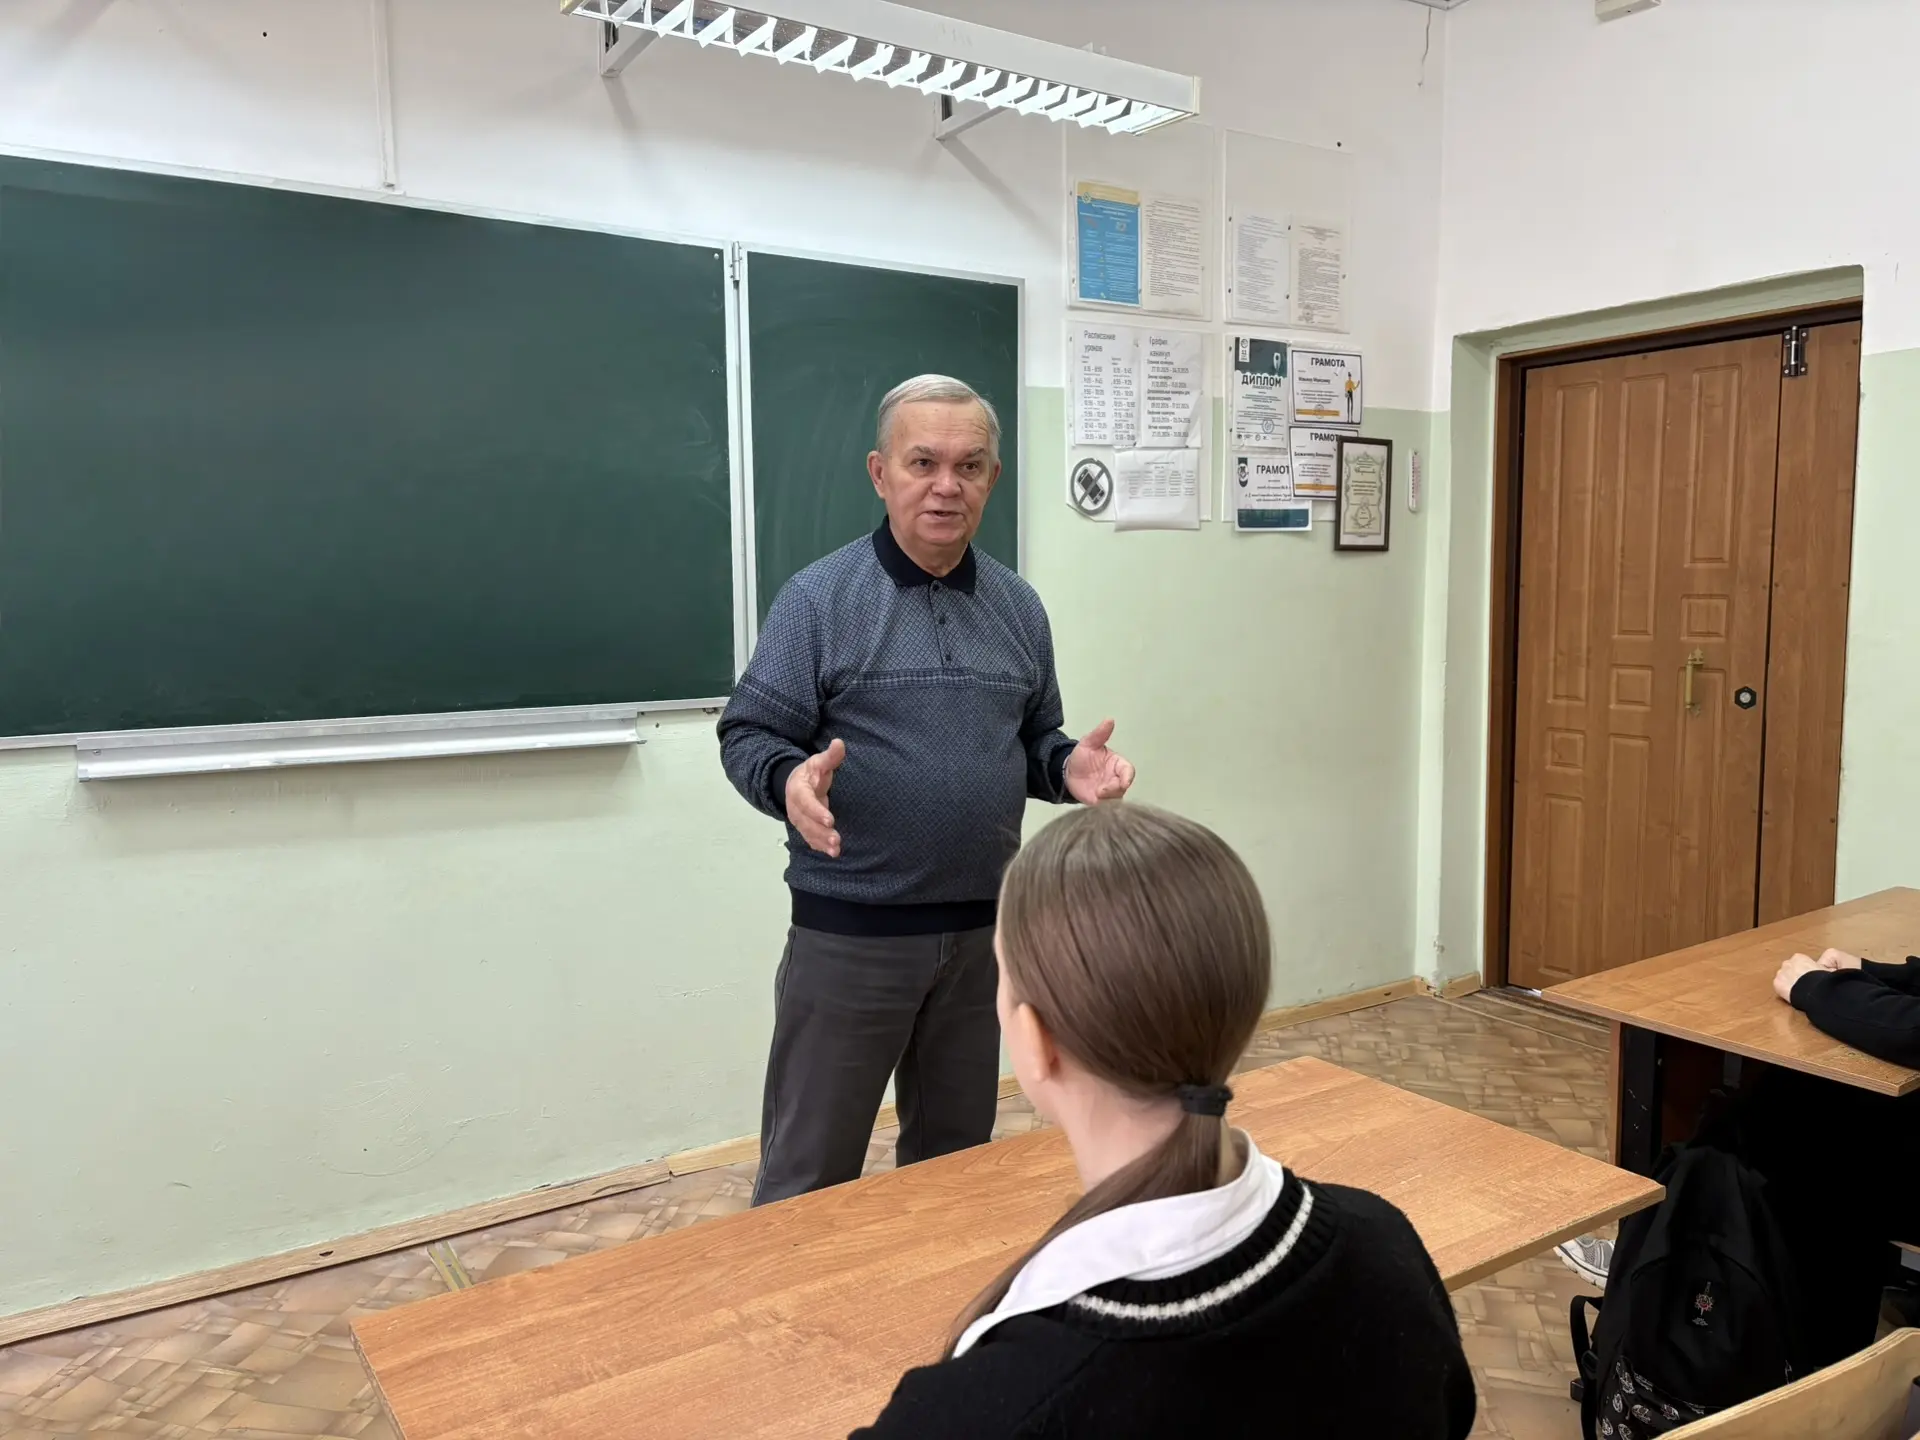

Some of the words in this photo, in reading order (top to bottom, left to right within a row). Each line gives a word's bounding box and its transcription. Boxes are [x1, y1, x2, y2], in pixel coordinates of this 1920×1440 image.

[1310, 357, 1346, 368] ГРАМОТА
[1241, 374, 1282, 388] ДИПЛОМ
[1309, 432, 1338, 442] ГРАМОТ
[1256, 464, 1290, 475] ГРАМОТ
